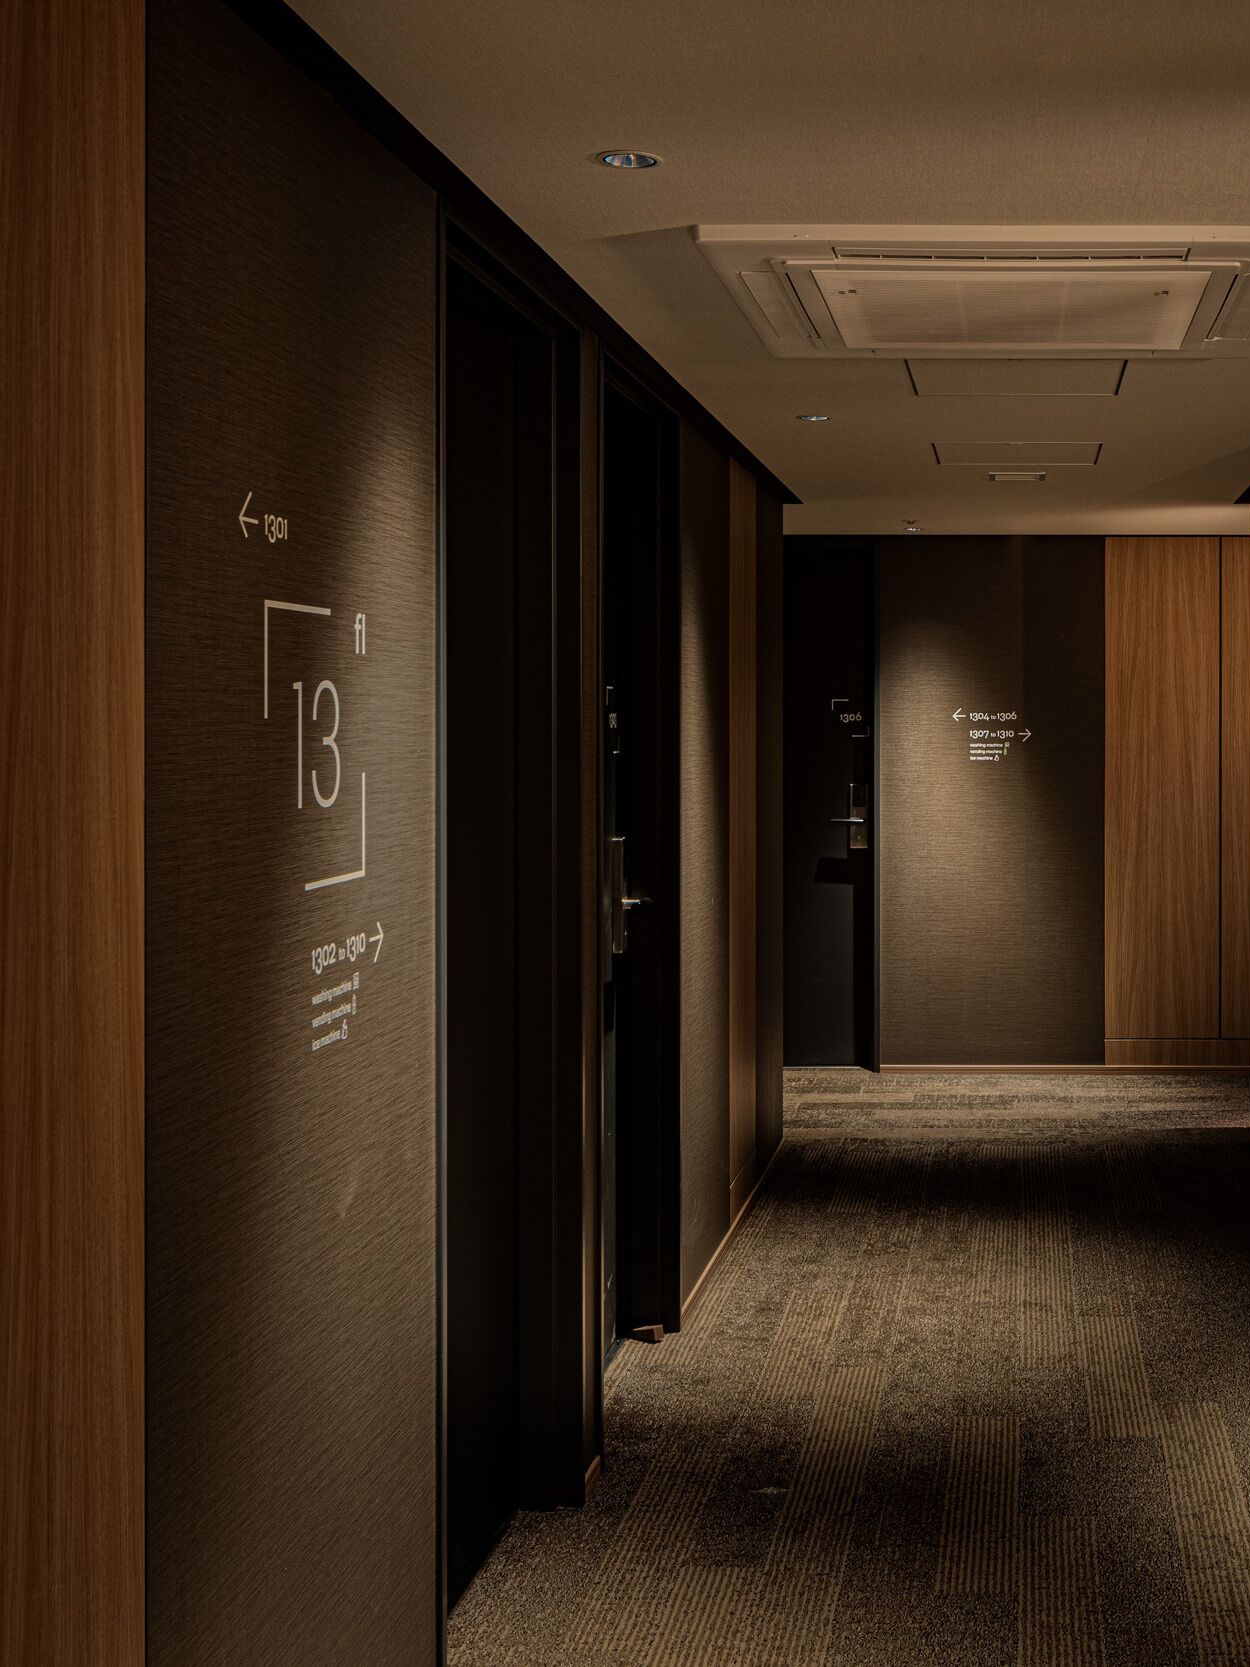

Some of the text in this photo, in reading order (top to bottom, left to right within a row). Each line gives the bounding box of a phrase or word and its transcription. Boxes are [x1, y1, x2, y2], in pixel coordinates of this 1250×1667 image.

[263, 513, 288, 544] 1301
[839, 712, 862, 723] 1306
[969, 712, 990, 721] 1304
[997, 710, 1017, 721] 1306
[292, 679, 341, 809] 13
[969, 730, 989, 739] 1307
[997, 730, 1014, 739] 1310
[311, 932, 366, 975] 1302 to 1310
